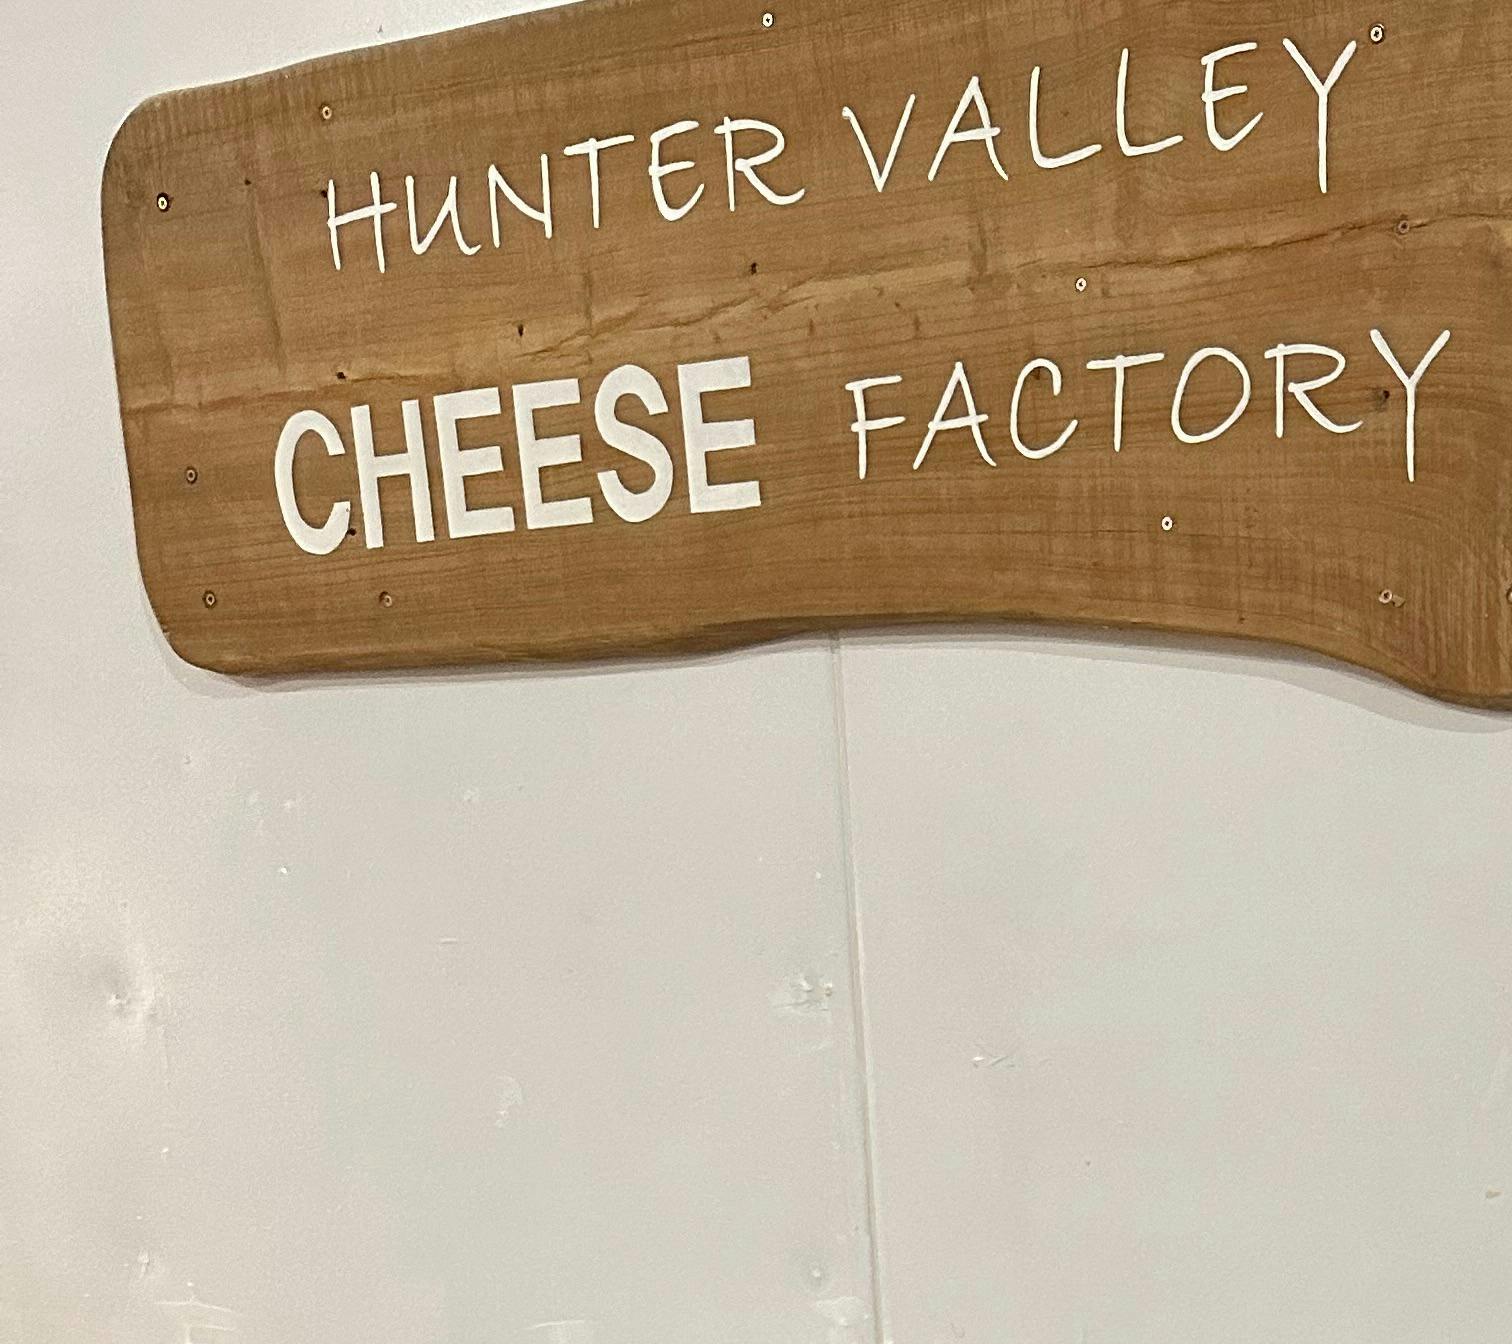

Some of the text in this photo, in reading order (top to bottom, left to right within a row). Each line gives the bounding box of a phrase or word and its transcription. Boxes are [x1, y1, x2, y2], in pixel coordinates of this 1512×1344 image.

[325, 37, 1358, 274] HUNTER VALLEY
[273, 327, 1452, 556] CHEESE FACTORY
